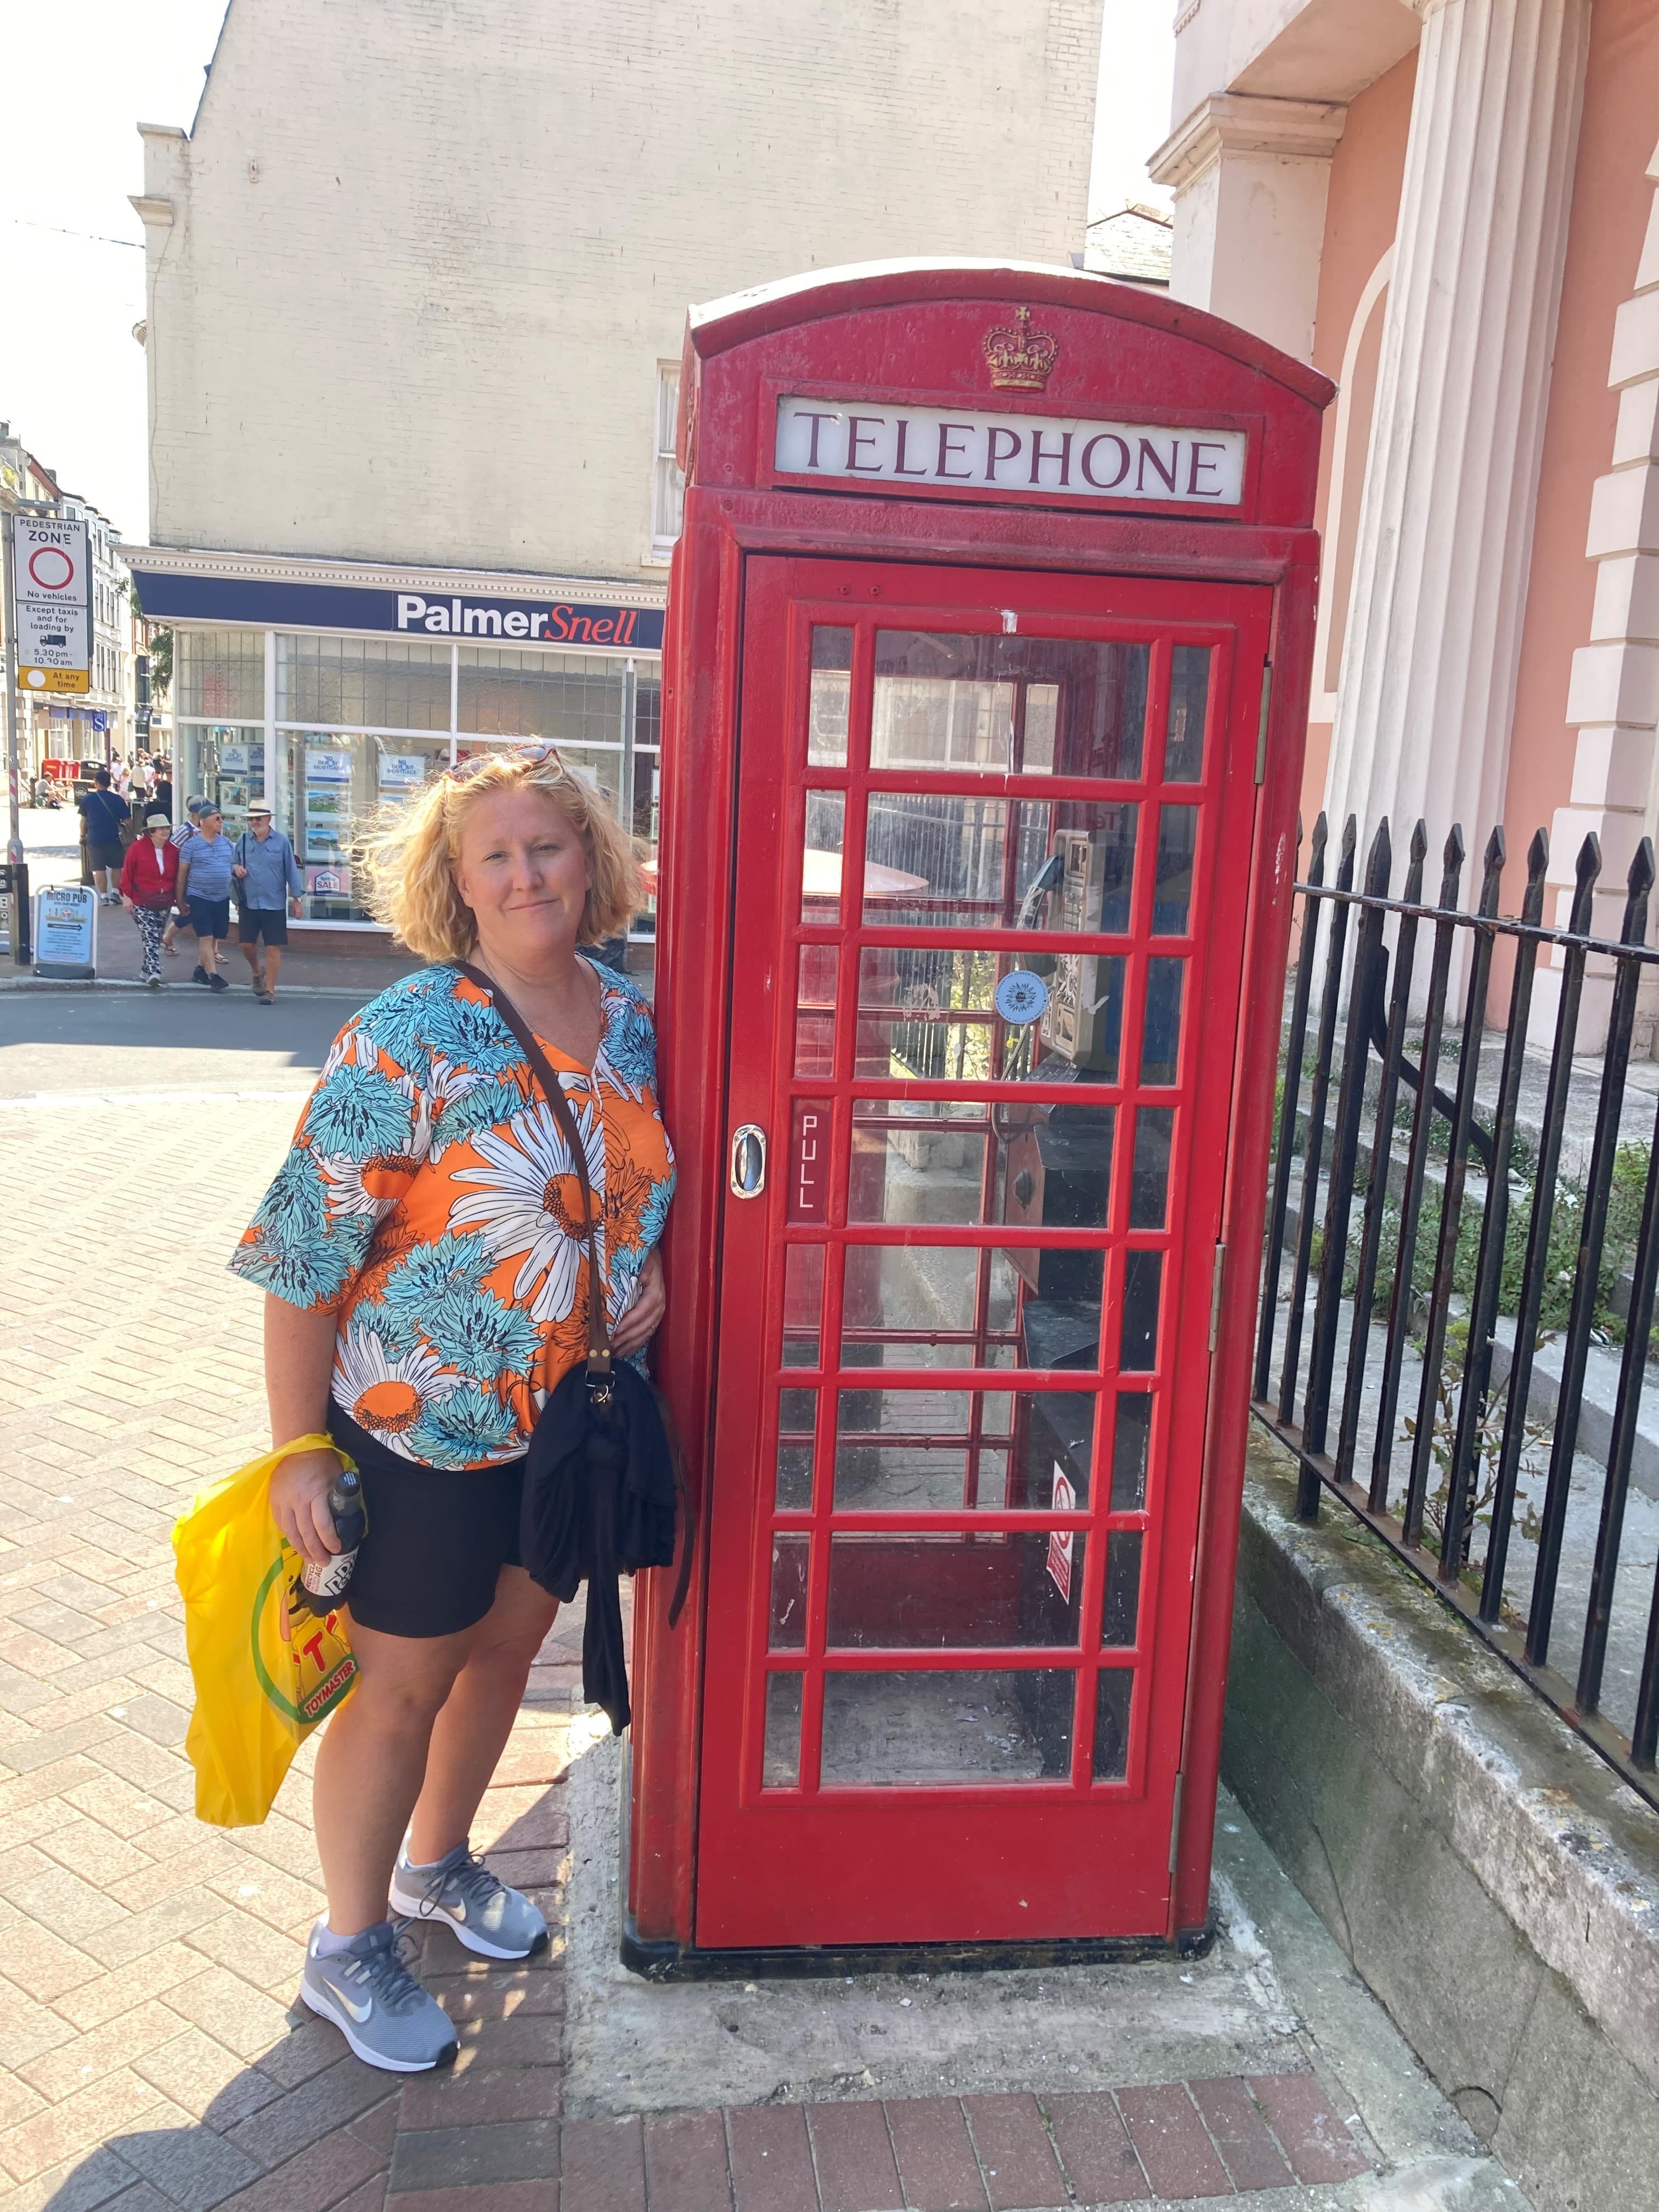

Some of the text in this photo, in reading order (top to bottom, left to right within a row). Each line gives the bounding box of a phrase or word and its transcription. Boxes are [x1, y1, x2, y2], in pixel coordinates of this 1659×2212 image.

[793, 411, 1227, 497] TELEPHONE
[20, 519, 80, 532] PEDESTRIAN
[29, 530, 71, 545] ZONE
[42, 592, 77, 601] vehicles
[26, 605, 55, 614] Except
[31, 622, 74, 633] loading by
[47, 891, 87, 903] MICRO PUB
[799, 1115, 818, 1208] PULL
[304, 1660, 355, 1718] TOYMASTER
